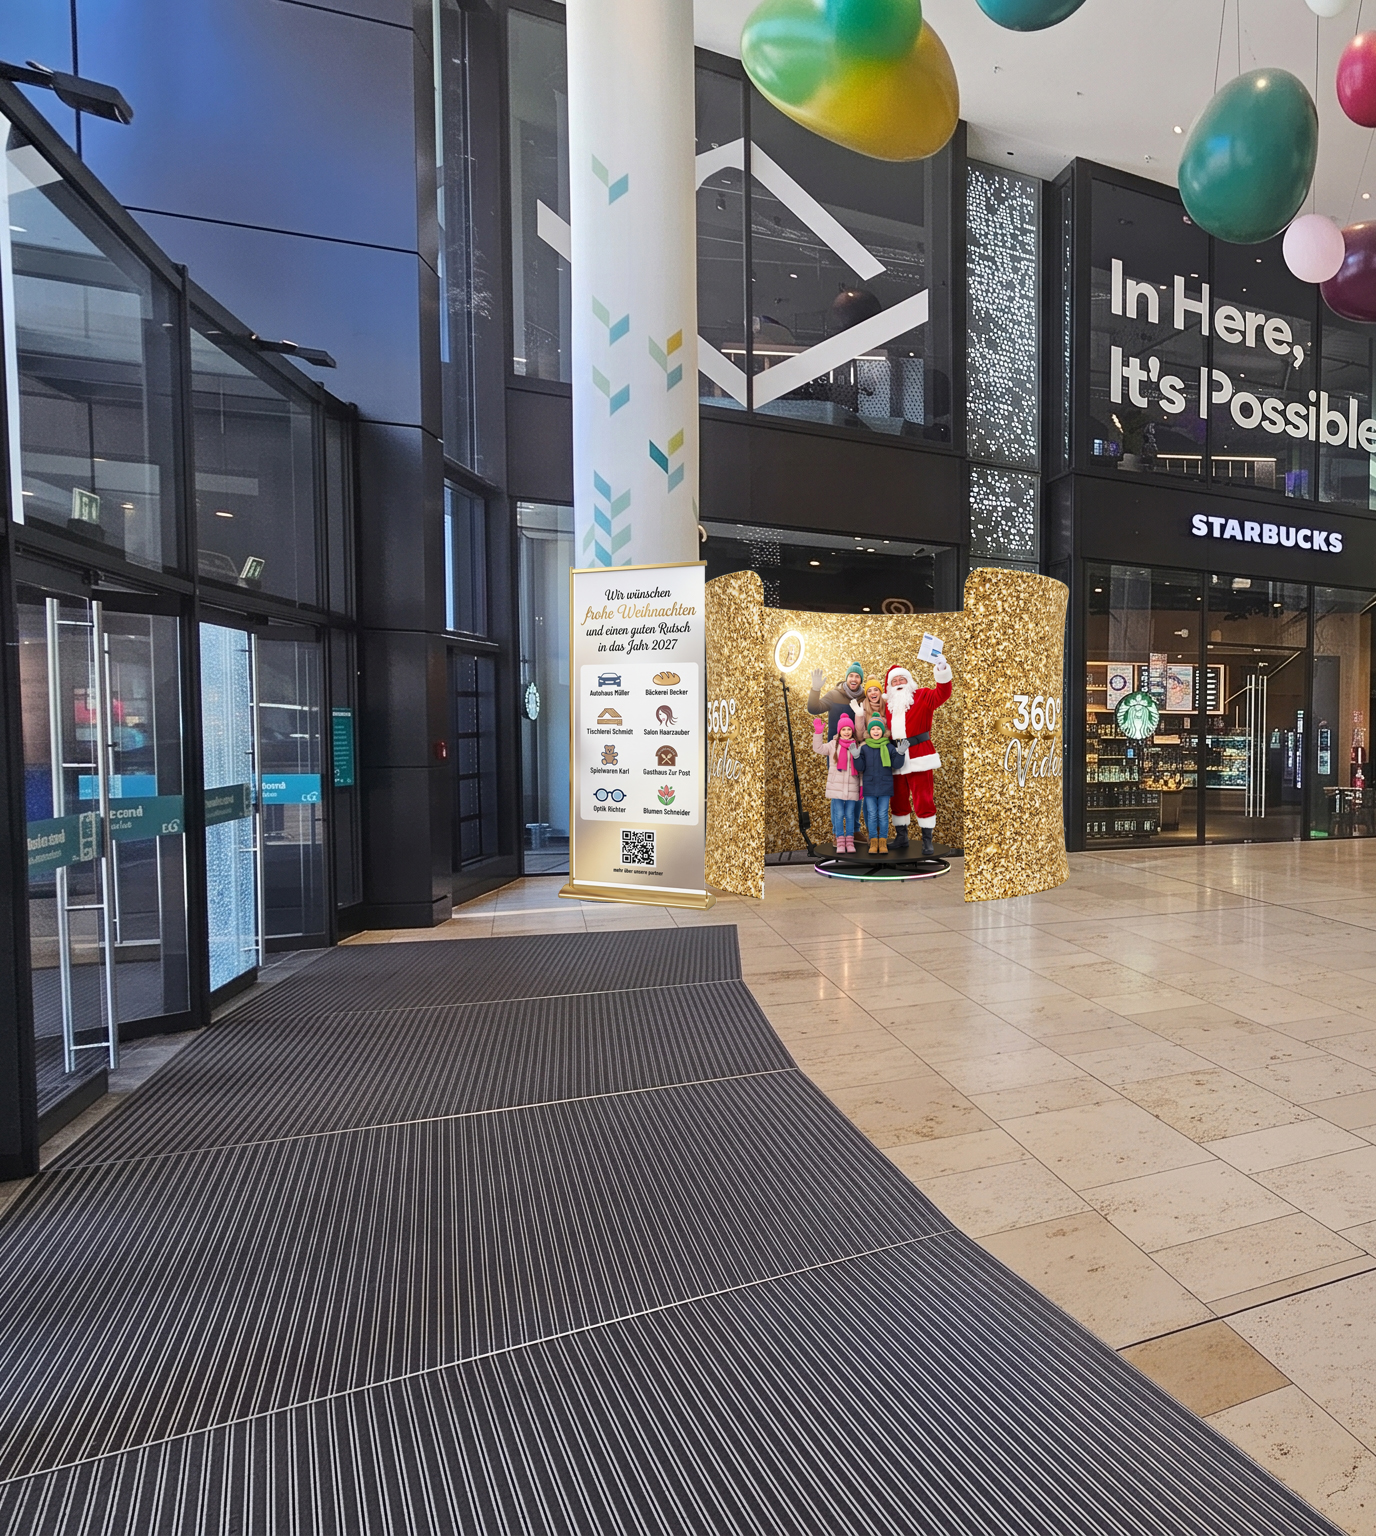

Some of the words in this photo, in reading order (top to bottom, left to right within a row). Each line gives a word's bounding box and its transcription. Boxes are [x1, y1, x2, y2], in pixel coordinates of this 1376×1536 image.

[1111, 258, 1159, 324] In
[1173, 274, 1304, 369] Here,
[1110, 345, 1186, 414] It's
[1191, 514, 1343, 553] STARBUCKS
[605, 589, 625, 601] Wir
[627, 587, 671, 600] wünschen
[581, 605, 614, 626] frohe
[617, 601, 697, 619] Weihnachten
[586, 625, 604, 636] und
[606, 626, 629, 636] einen
[630, 624, 656, 639] guten
[658, 621, 691, 635] Rutsch
[598, 642, 607, 652] in
[609, 640, 625, 652] das
[626, 639, 650, 655] Jahr
[651, 639, 678, 651] 2027
[590, 767, 618, 775] Spielwaren
[643, 807, 662, 815] Blumen
[663, 808, 690, 816] Schneider
